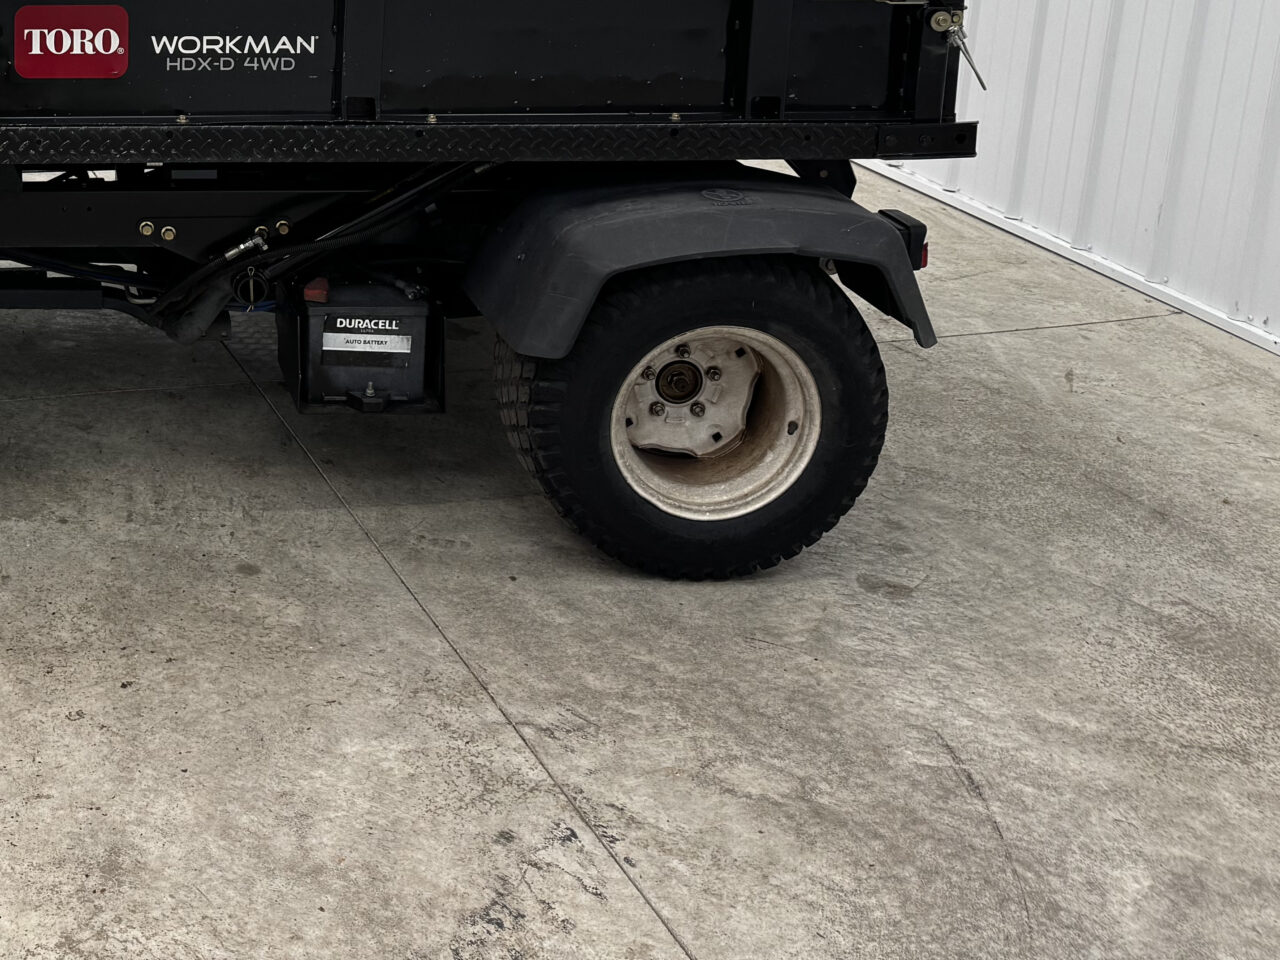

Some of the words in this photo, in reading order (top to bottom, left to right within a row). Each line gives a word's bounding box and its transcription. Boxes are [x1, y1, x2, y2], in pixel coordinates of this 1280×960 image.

[24, 28, 120, 55] TORO
[151, 35, 316, 54] WORKMAN
[166, 57, 234, 71] HDX-D
[243, 57, 296, 71] 4WD
[336, 318, 399, 330] DURACELL
